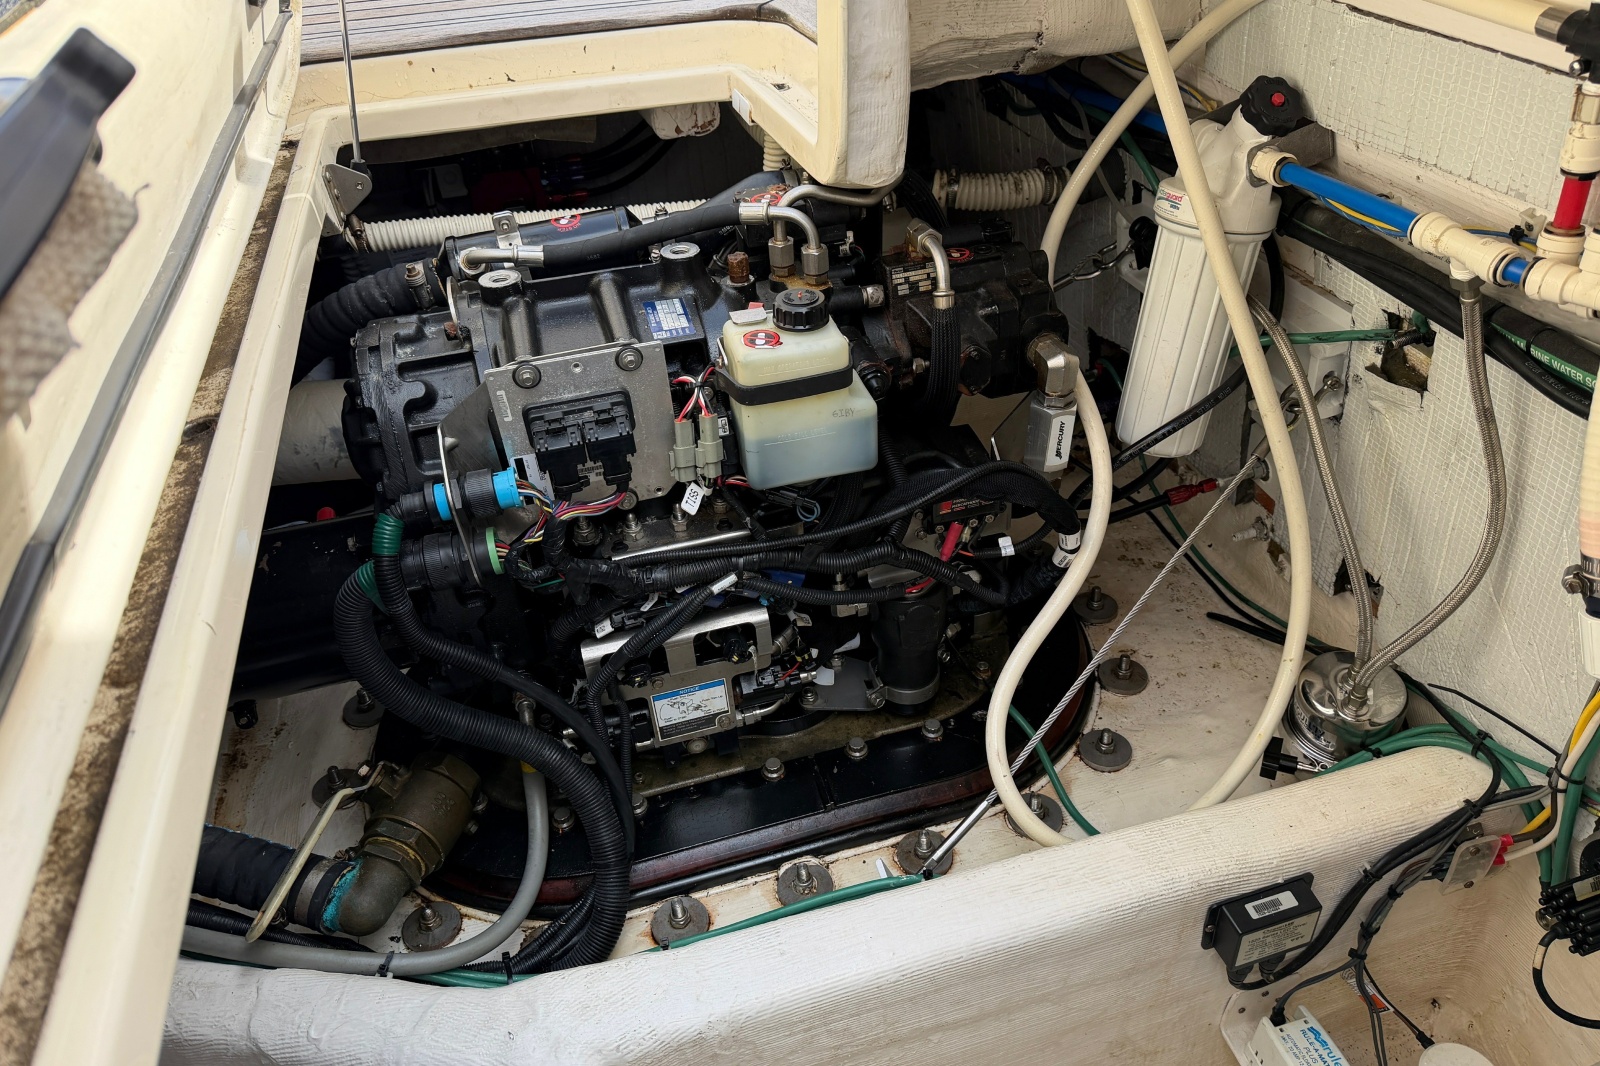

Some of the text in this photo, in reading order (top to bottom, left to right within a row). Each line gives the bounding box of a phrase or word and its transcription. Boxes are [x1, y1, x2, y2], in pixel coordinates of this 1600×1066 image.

[1551, 359, 1584, 384] WATER
[1055, 421, 1066, 460] MERCURY
[680, 686, 700, 694] NOTICE
[1303, 1046, 1319, 1064] PLUS
